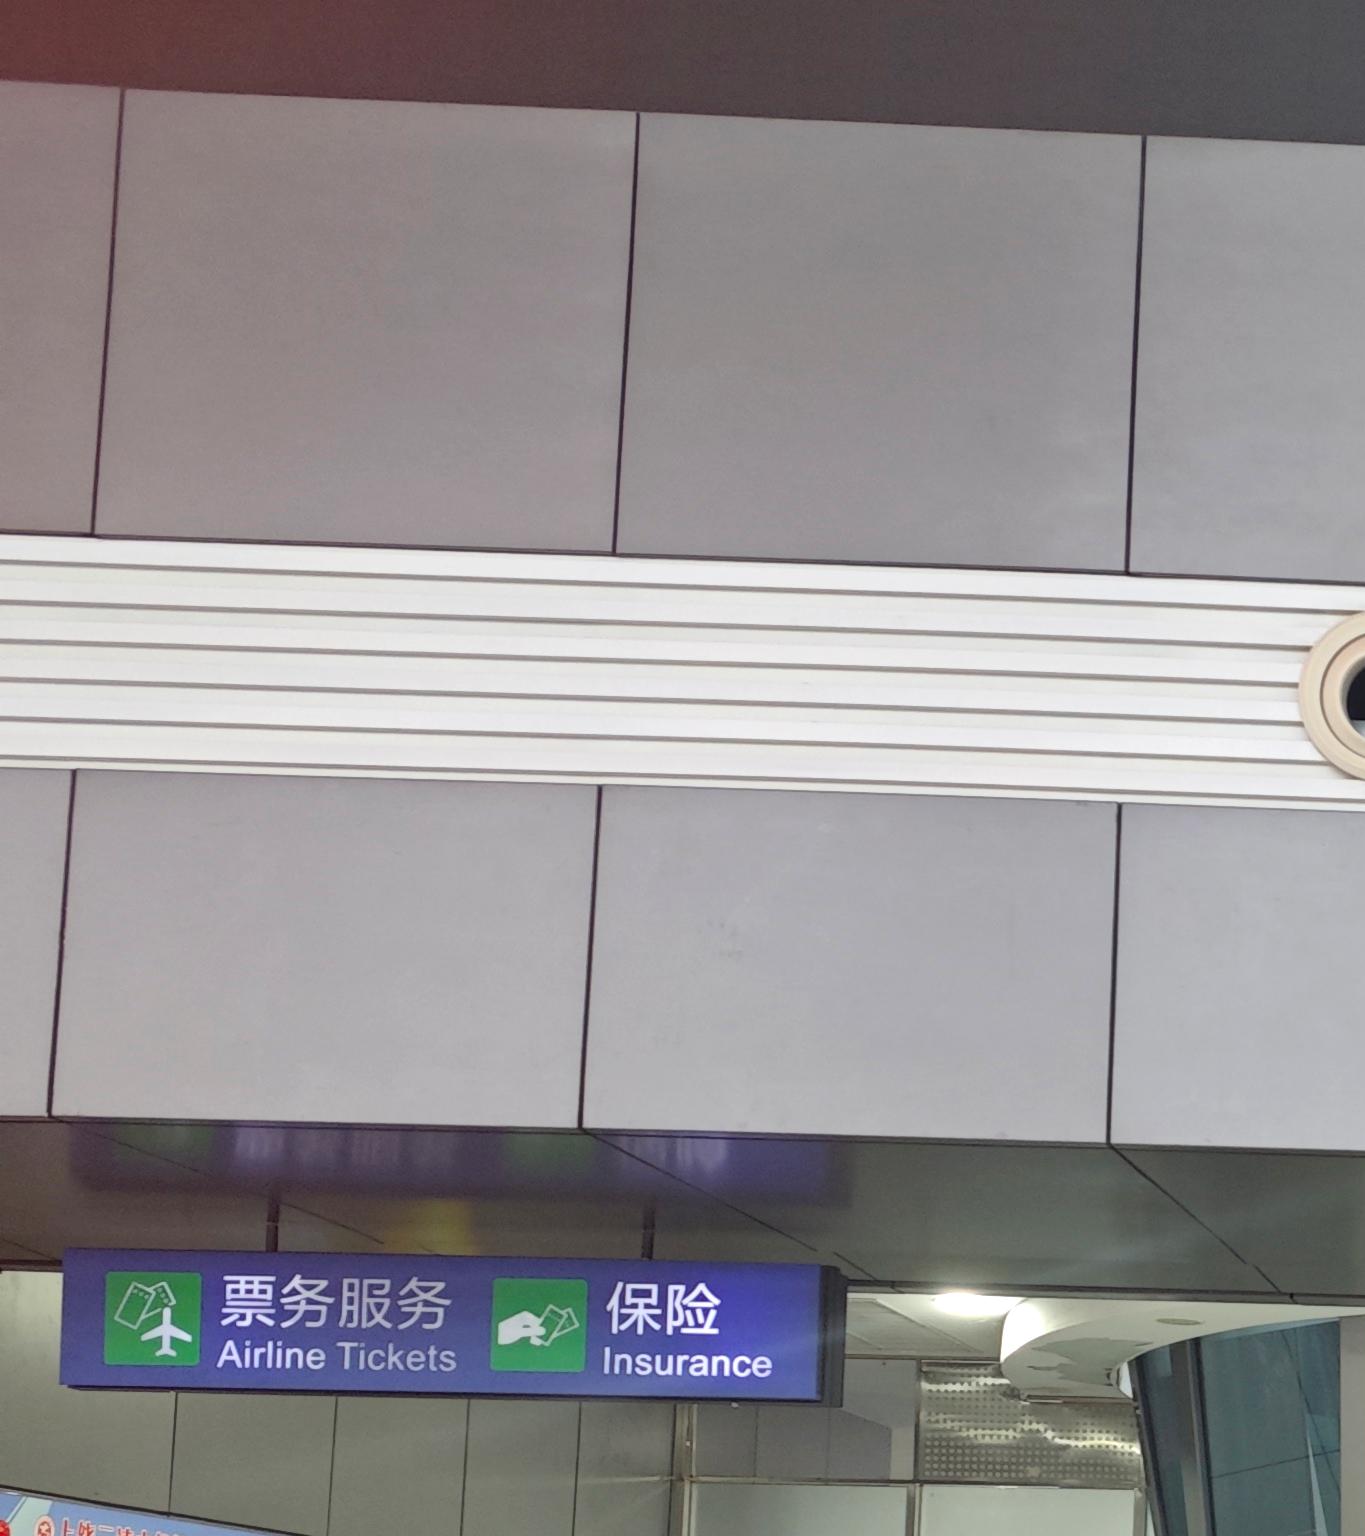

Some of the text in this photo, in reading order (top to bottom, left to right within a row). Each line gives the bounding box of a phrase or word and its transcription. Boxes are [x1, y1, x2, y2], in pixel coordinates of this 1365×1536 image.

[220, 1274, 452, 1329] 票务服务
[606, 1281, 721, 1336] 保险
[216, 1339, 457, 1371] Airline Tickets
[603, 1346, 773, 1378] Insurance
